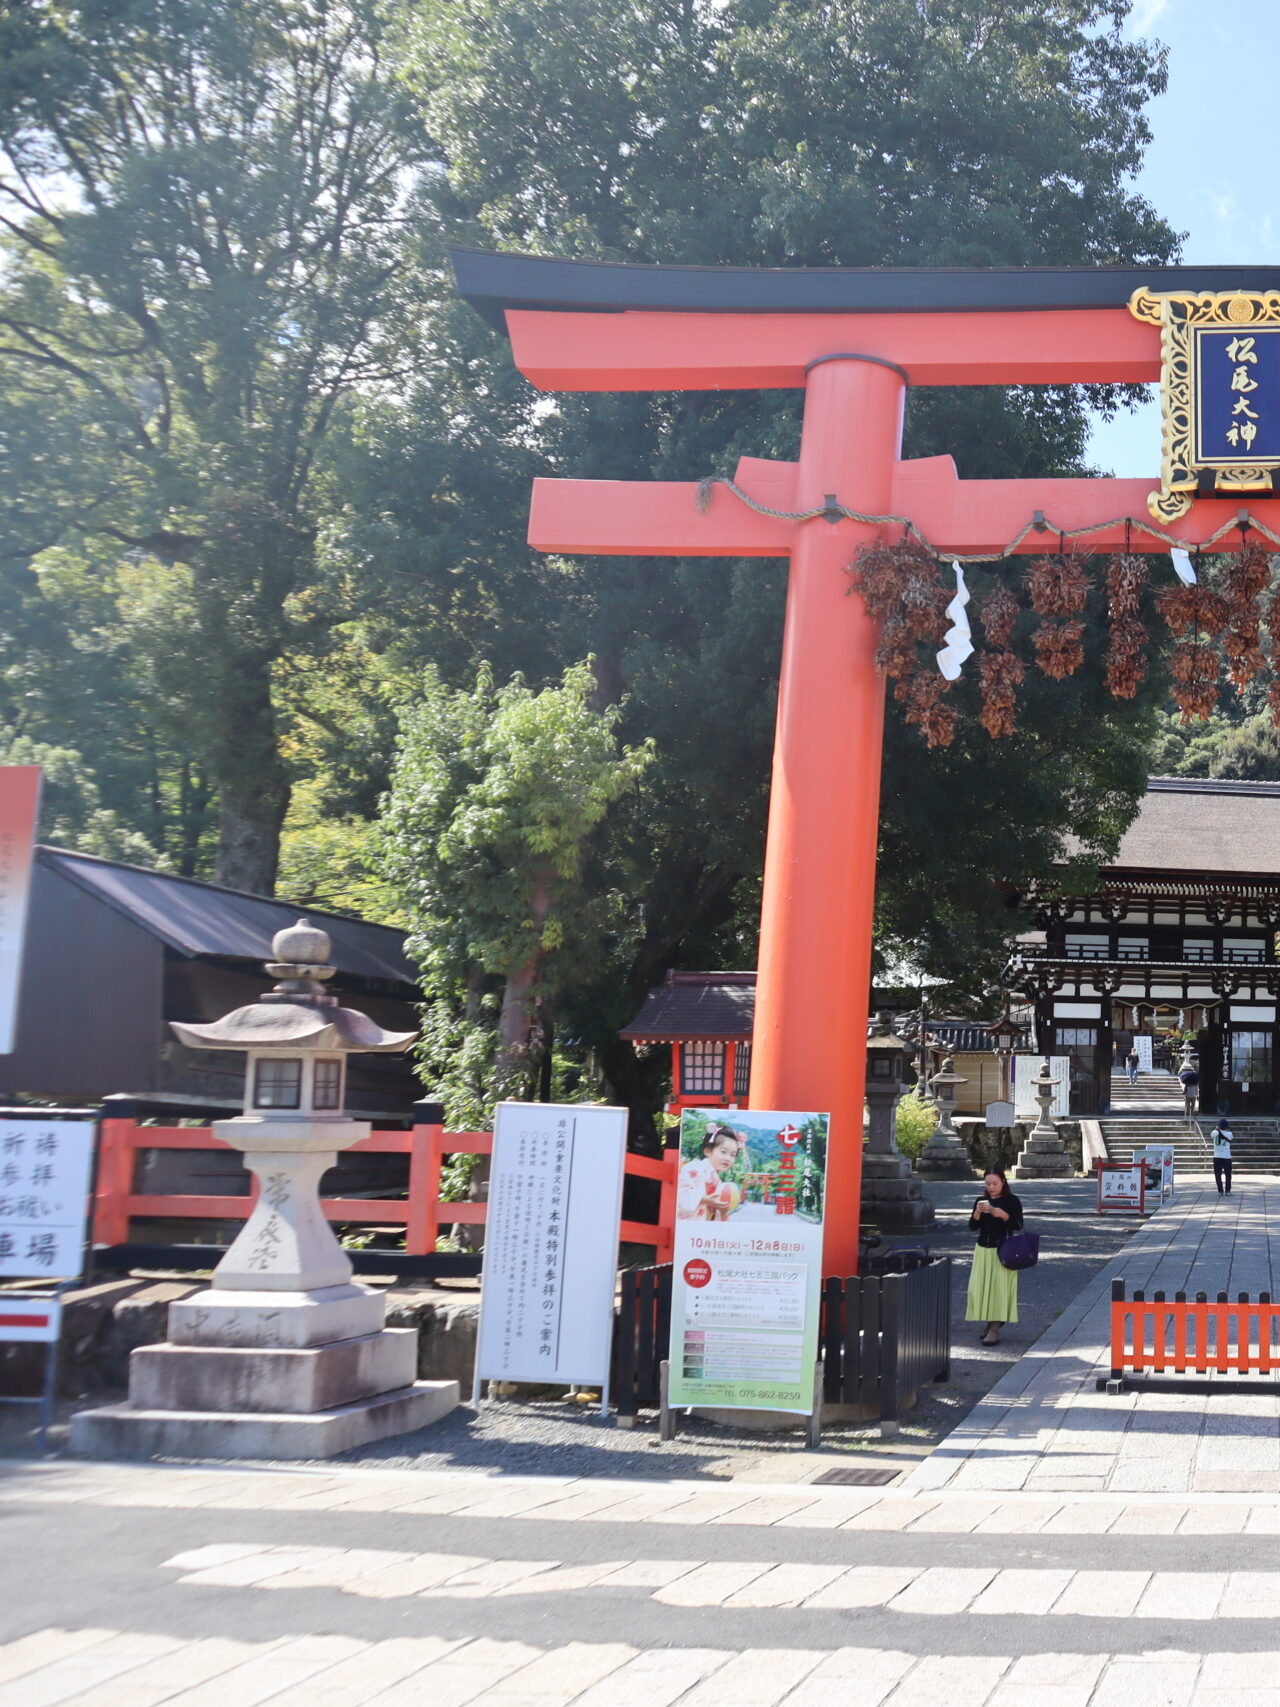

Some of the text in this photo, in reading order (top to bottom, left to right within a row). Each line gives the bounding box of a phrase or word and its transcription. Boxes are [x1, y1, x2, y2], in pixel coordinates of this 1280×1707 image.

[1225, 337, 1259, 451] 松尾大神
[0, 1162, 57, 1187] 参拝
[776, 1126, 799, 1215] 七五三詣
[802, 1158, 813, 1198] 松尾大社
